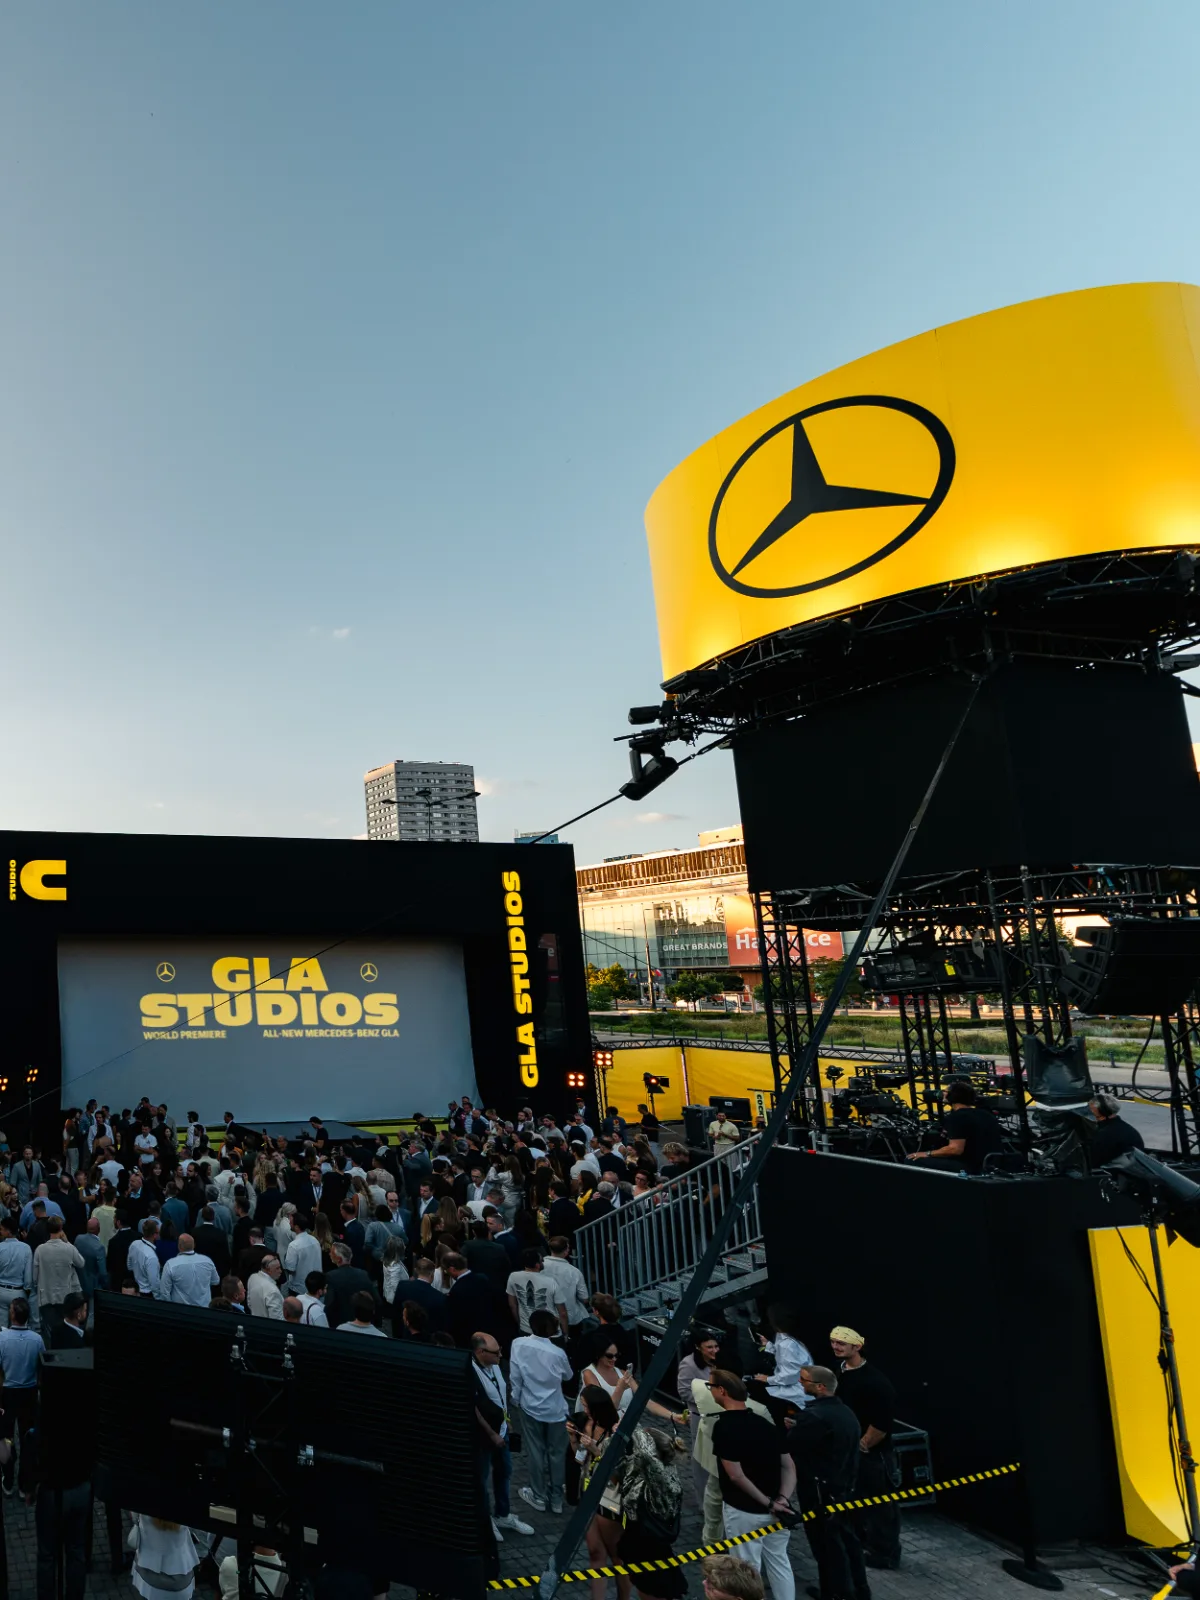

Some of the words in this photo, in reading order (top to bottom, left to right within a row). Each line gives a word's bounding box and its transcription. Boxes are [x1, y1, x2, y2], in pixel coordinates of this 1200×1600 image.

[20, 859, 67, 901] C
[502, 871, 532, 1014] STUDIOS
[662, 944, 690, 952] GREAT
[691, 942, 728, 950] BRANDS
[211, 956, 329, 992] GLA
[139, 992, 400, 1027] STUDIOS
[143, 1031, 179, 1040] WORLD
[180, 1030, 227, 1039] PREMIERE
[263, 1029, 303, 1038] ALL-NEW
[305, 1029, 380, 1038] MERCEDES-BENZ
[381, 1029, 400, 1038] GLA
[516, 1022, 539, 1088] GLA
